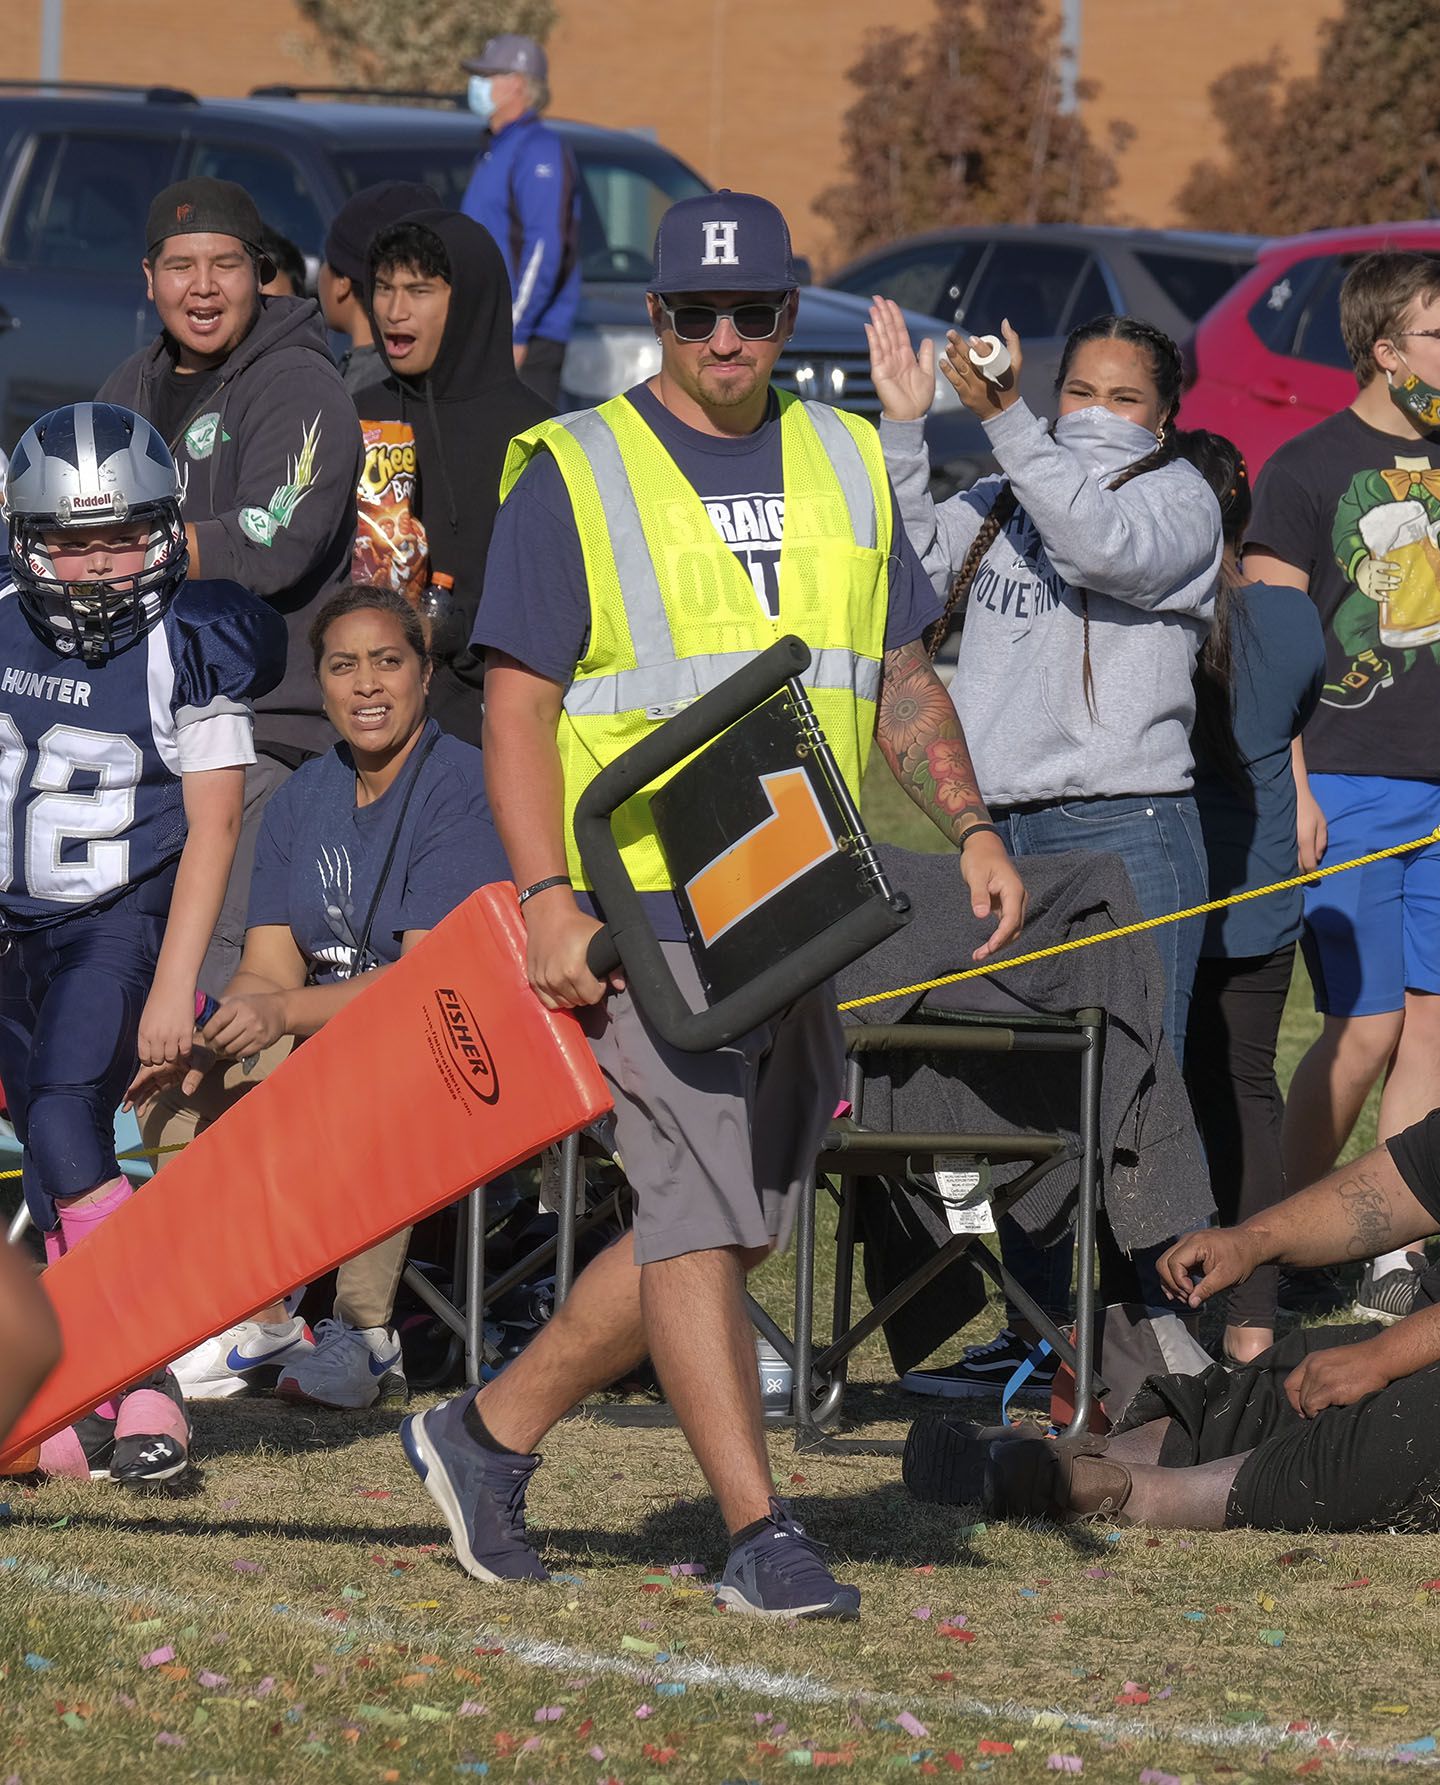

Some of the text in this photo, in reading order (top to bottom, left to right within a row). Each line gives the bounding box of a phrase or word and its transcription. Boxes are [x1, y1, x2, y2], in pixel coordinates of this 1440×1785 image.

[701, 220, 739, 265] H
[359, 445, 416, 496] Chee
[73, 493, 111, 508] Riddell
[1, 667, 92, 708] HUNTER
[438, 988, 489, 1076] FISHER
